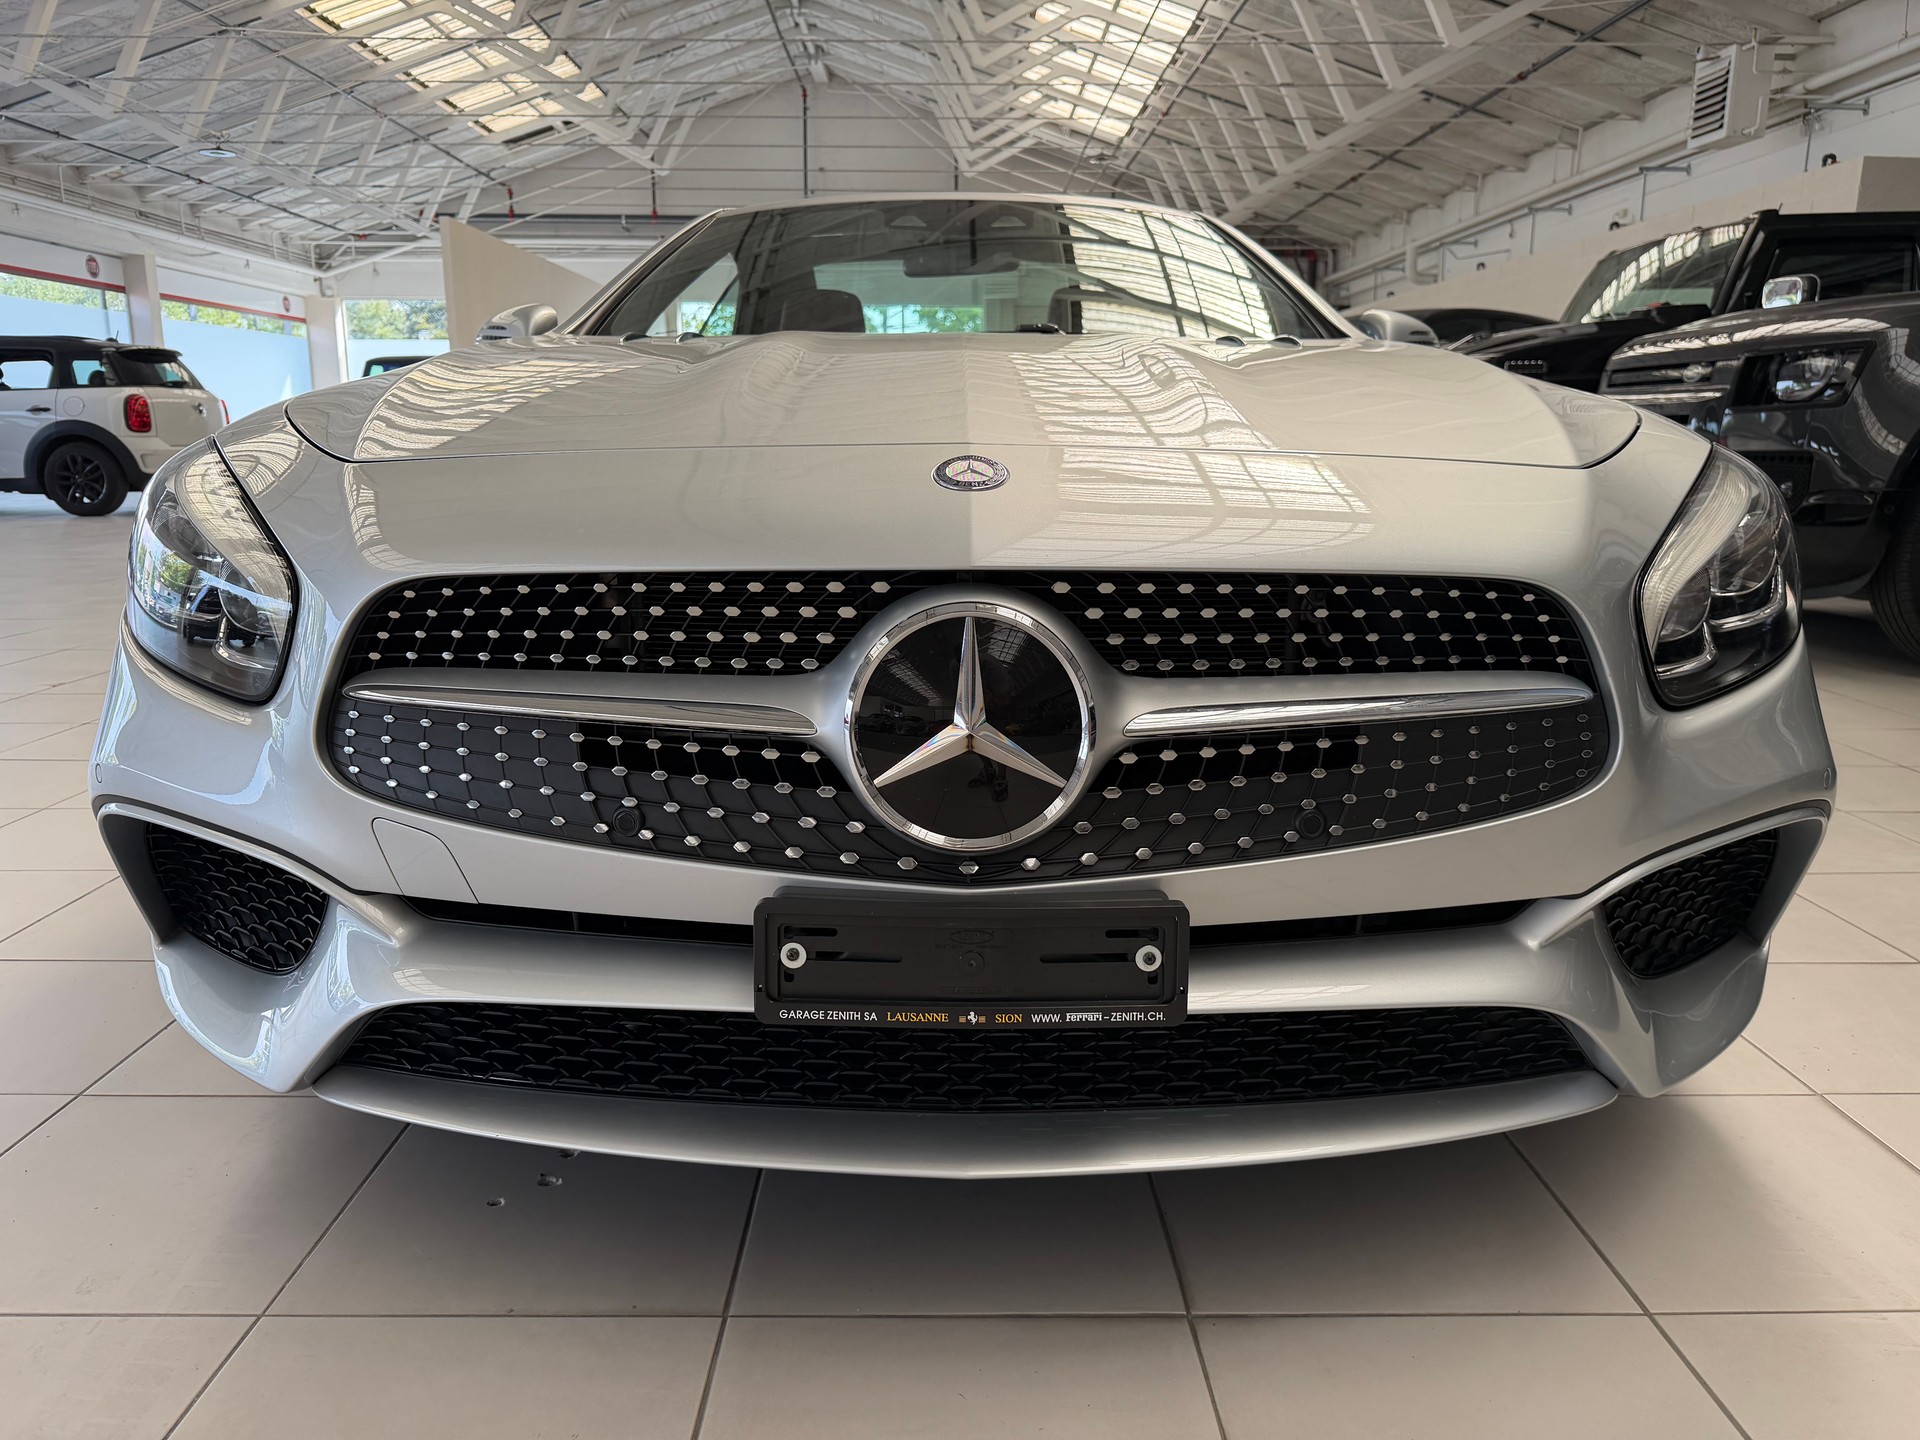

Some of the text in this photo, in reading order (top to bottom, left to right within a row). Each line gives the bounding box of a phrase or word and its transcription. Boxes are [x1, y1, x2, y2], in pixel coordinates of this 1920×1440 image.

[779, 1009, 825, 1020] GARAGE
[826, 1010, 861, 1021] ZENITH
[863, 1011, 878, 1022] SA
[886, 1011, 949, 1023] LAUSANNE
[994, 1013, 1023, 1024] SION
[1031, 1013, 1063, 1024] WWW.
